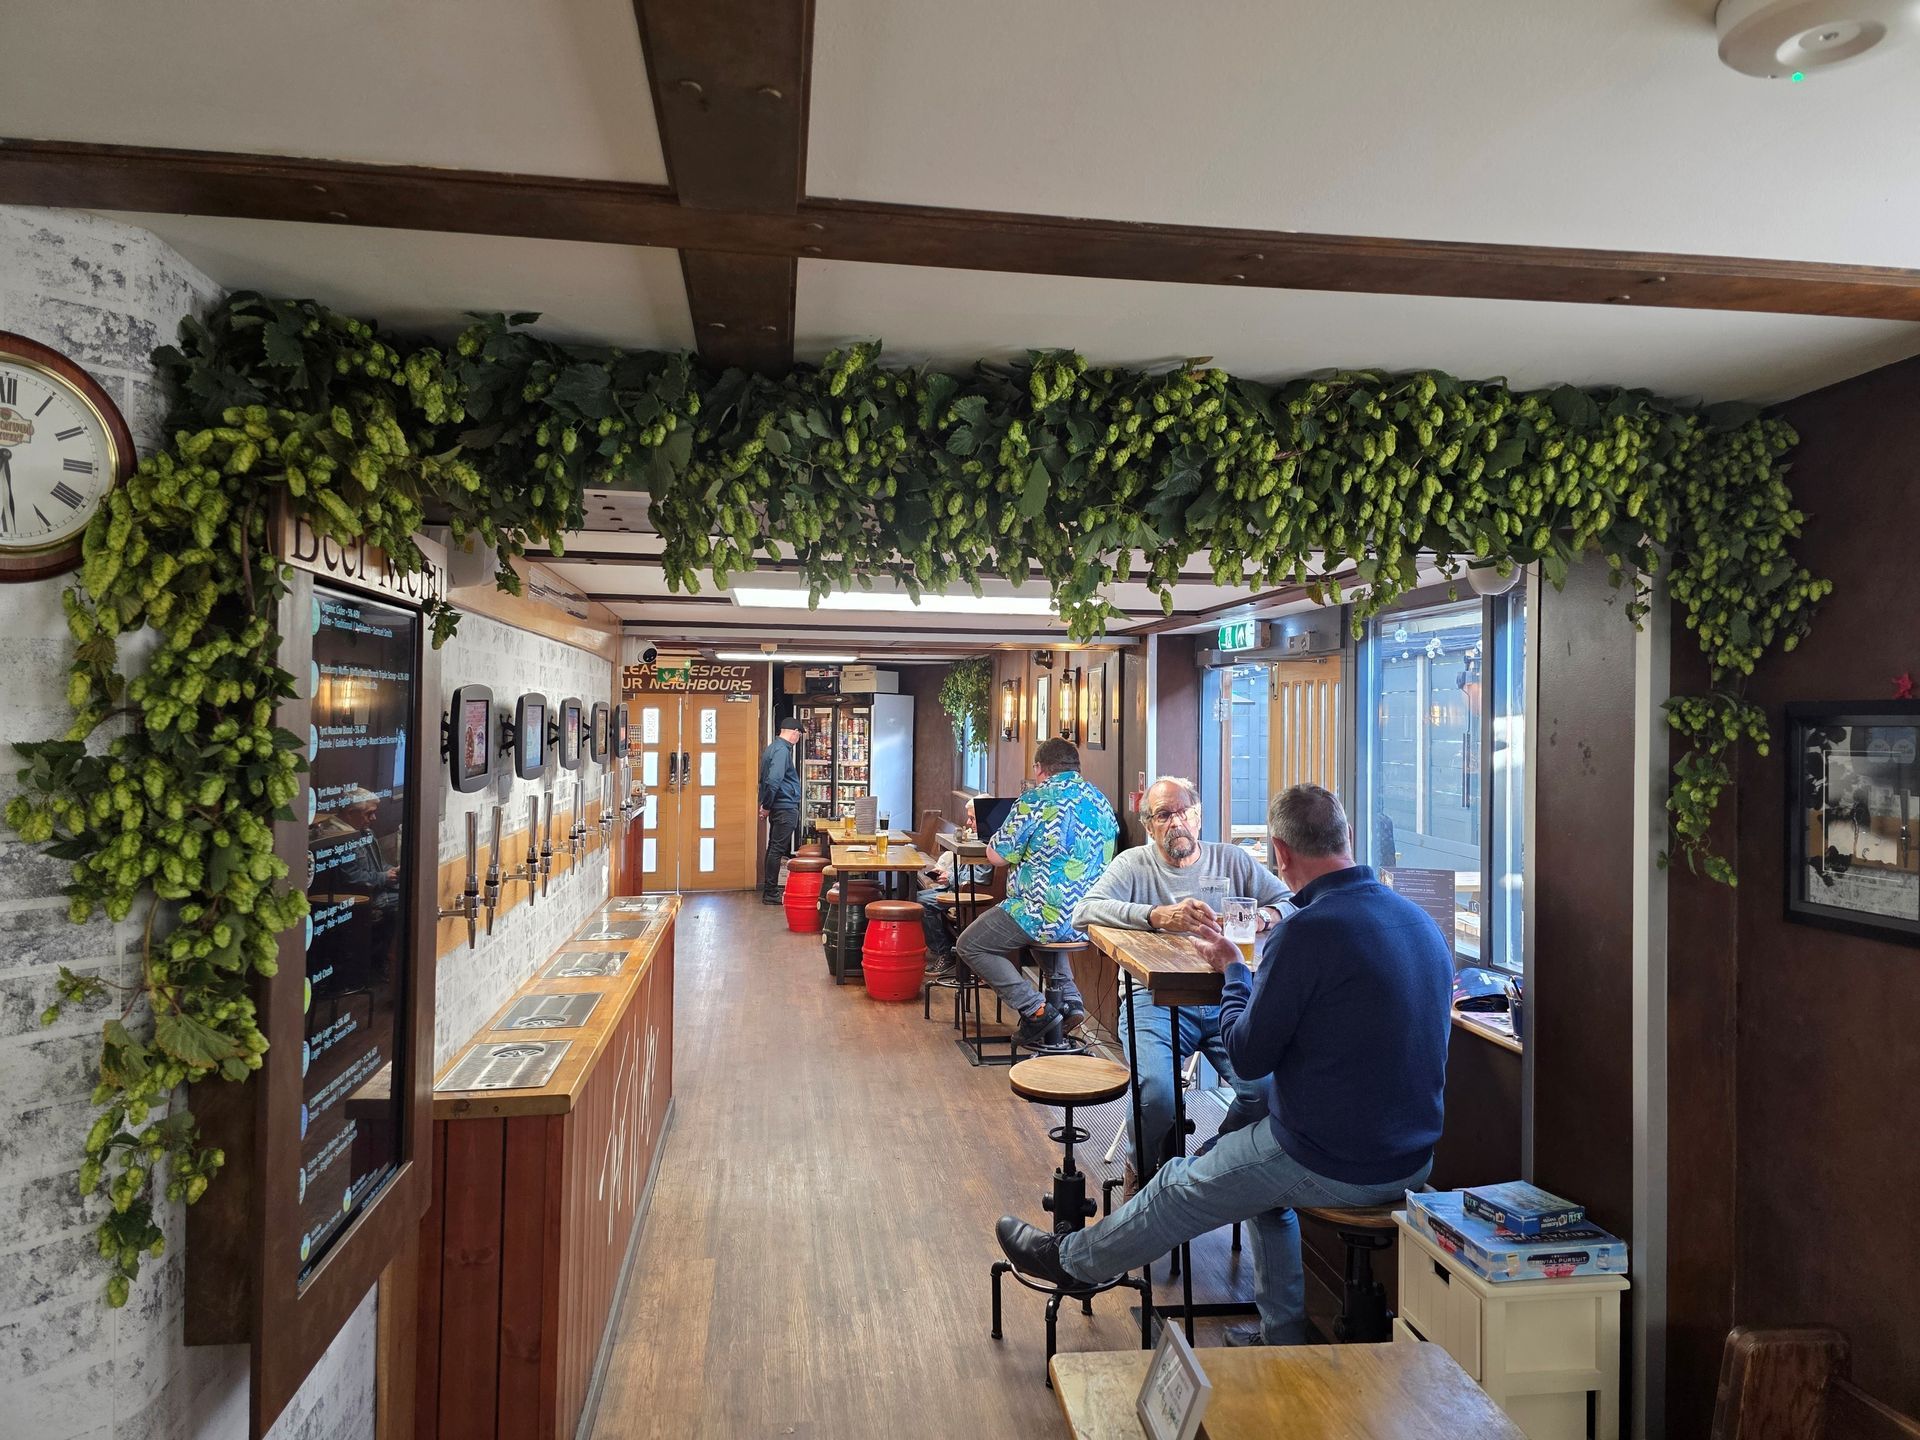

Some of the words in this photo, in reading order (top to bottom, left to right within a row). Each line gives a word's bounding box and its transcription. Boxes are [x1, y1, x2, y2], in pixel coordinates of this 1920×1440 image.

[623, 664, 658, 675] LEAS
[689, 665, 751, 677] ESPECT
[622, 677, 642, 689] UR
